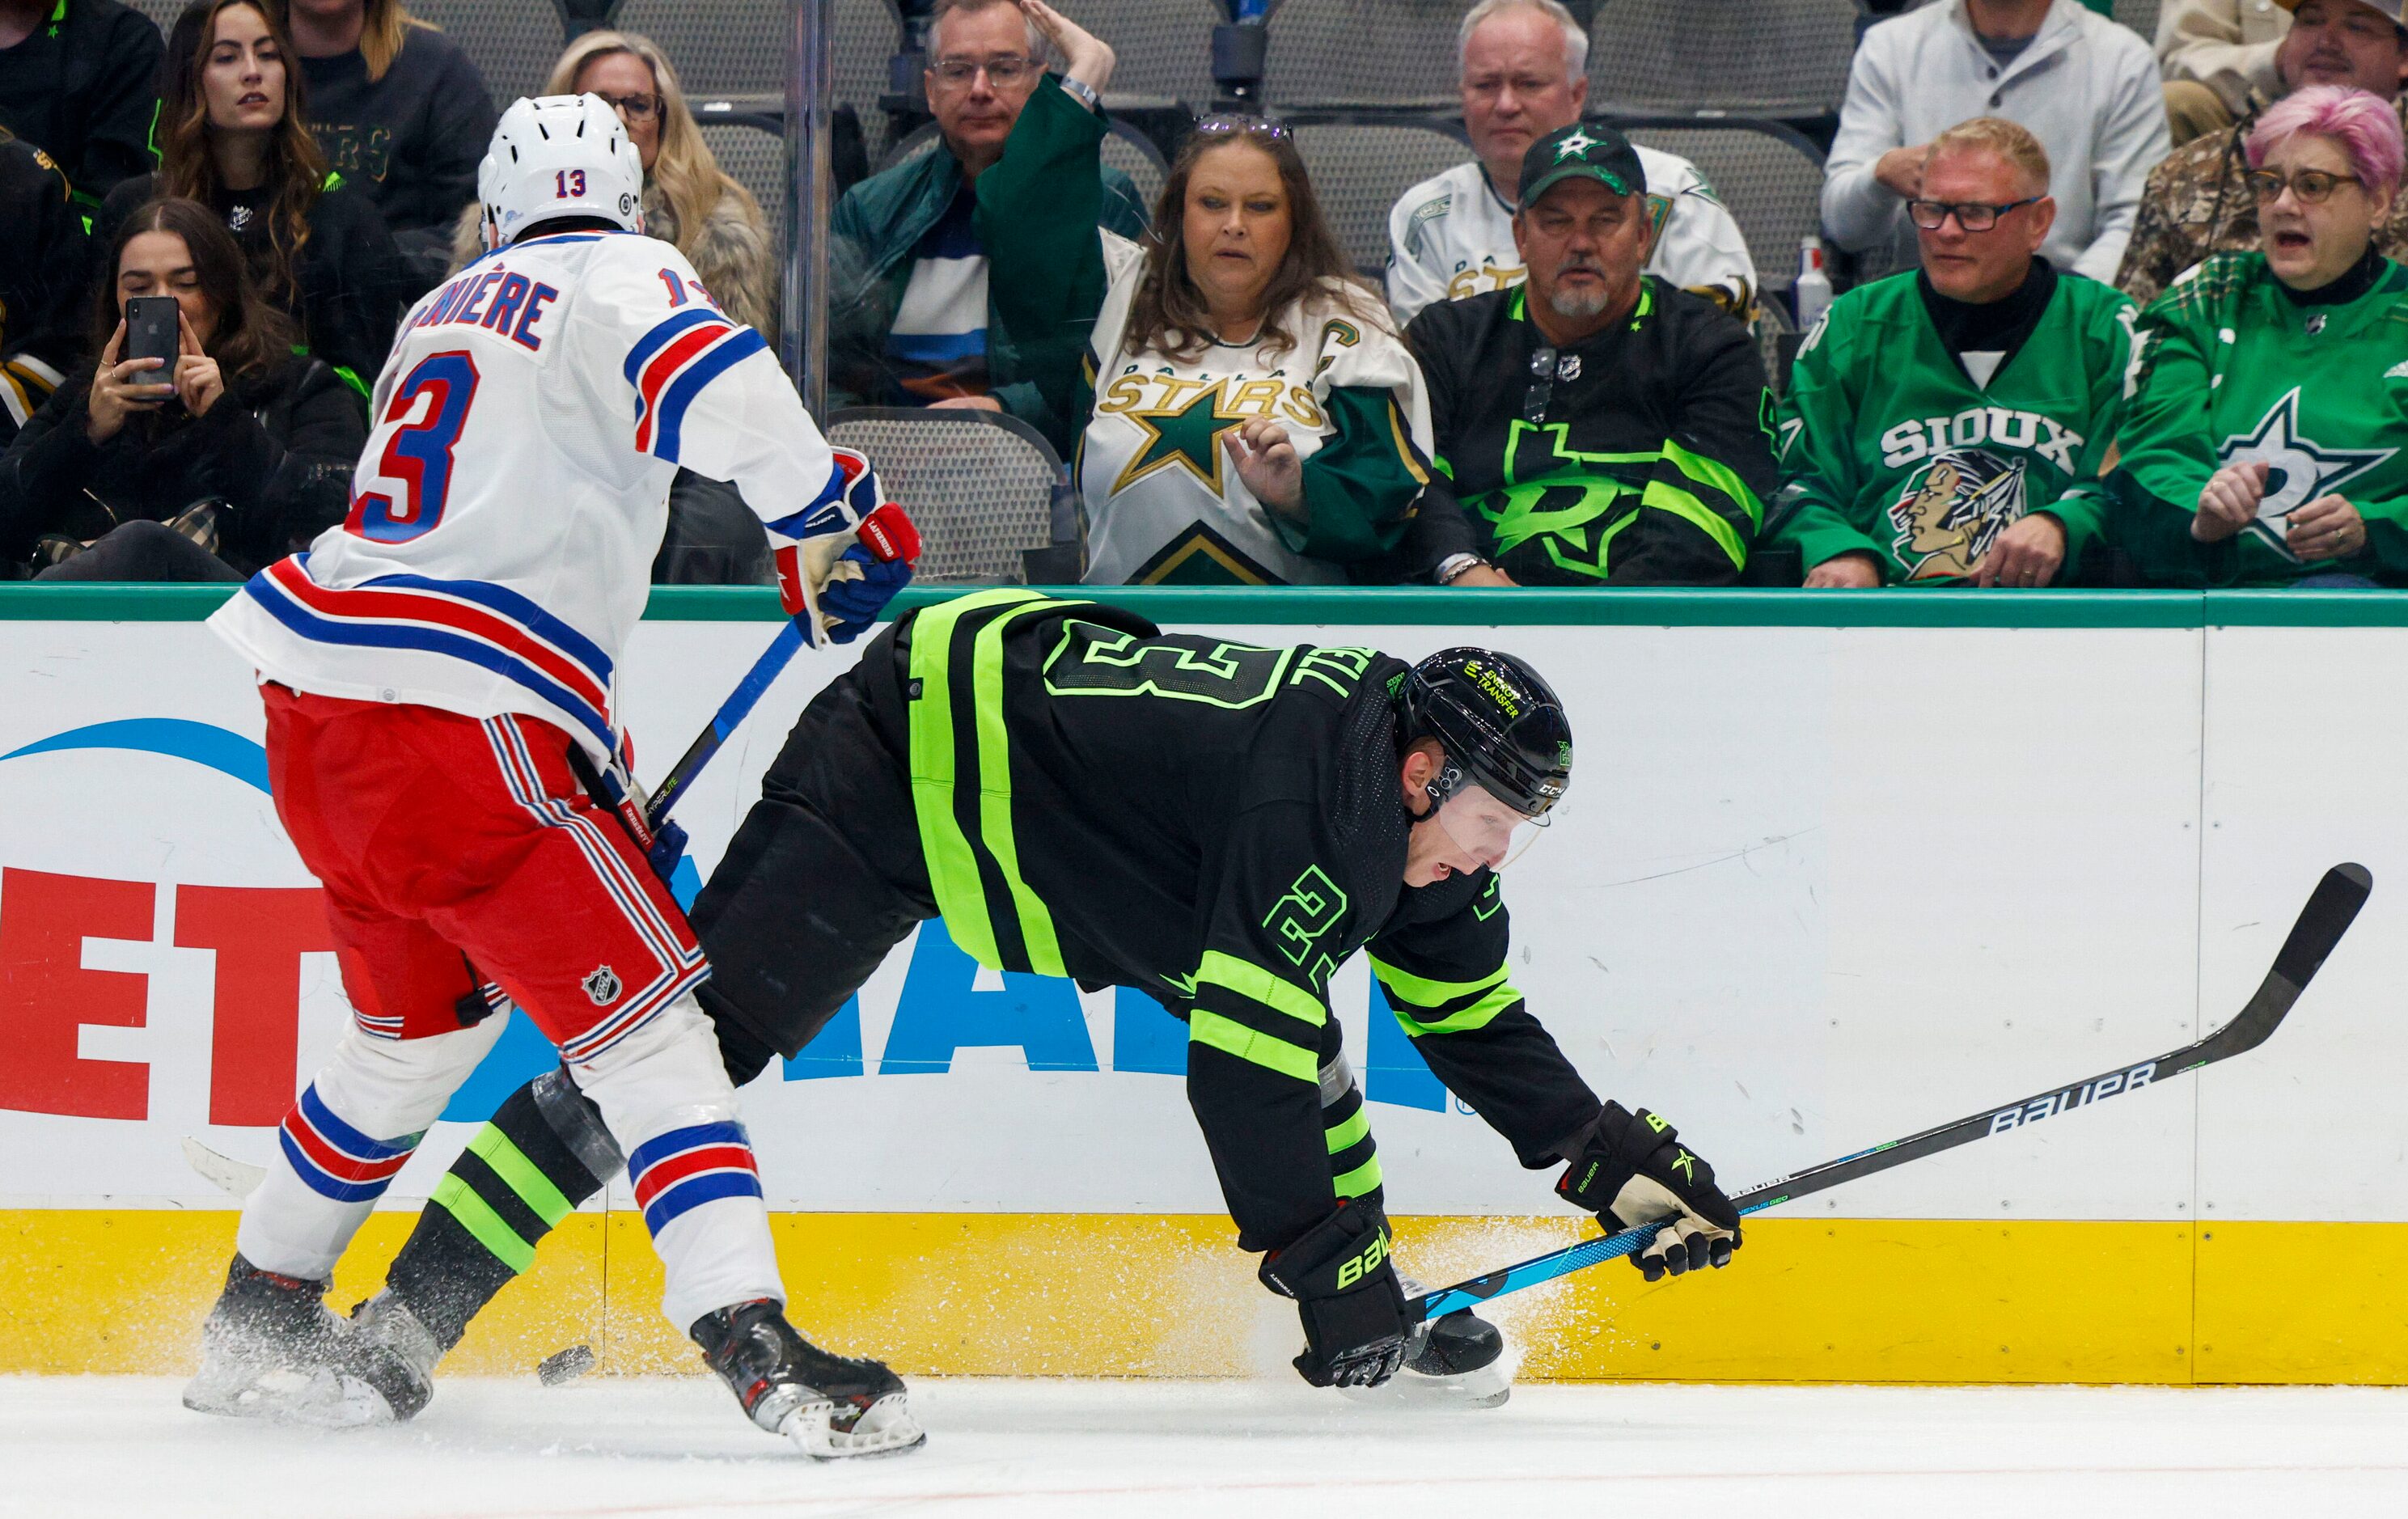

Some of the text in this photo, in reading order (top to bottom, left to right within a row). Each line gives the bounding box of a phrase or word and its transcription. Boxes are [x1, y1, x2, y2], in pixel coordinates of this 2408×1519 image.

[557, 169, 586, 199] 13
[1098, 372, 1323, 428] STARS
[1880, 406, 2085, 477] SIOUX
[1477, 675, 1519, 719] TRANSFER
[1485, 668, 1518, 702] ENERGY
[1987, 1061, 2157, 1137] BAUER
[1577, 1161, 1599, 1194] BAUER
[1728, 1175, 1792, 1201] BAUER
[1737, 1195, 1788, 1216] NEXUS GEO
